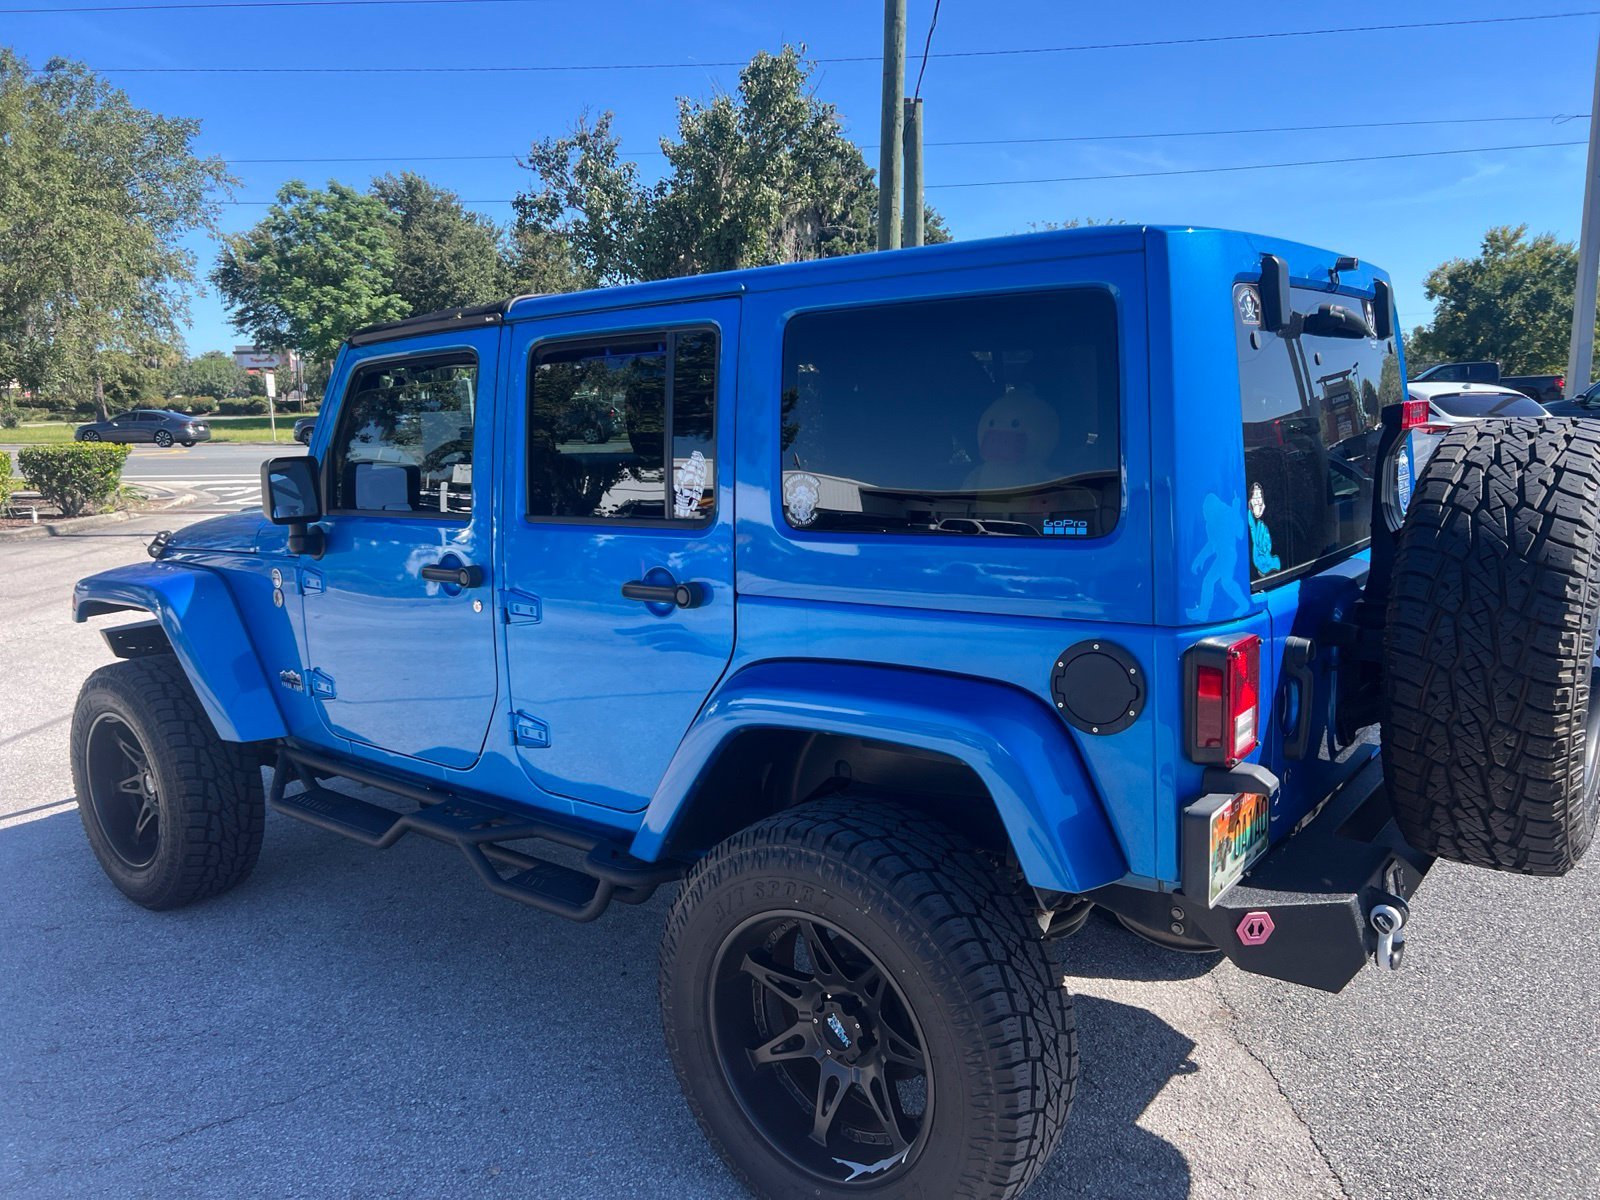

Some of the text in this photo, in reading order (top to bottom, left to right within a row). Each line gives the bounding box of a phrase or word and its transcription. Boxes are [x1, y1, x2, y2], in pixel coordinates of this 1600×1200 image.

[1043, 519, 1088, 527] GoPro
[713, 880, 836, 923] A/T SPORT
